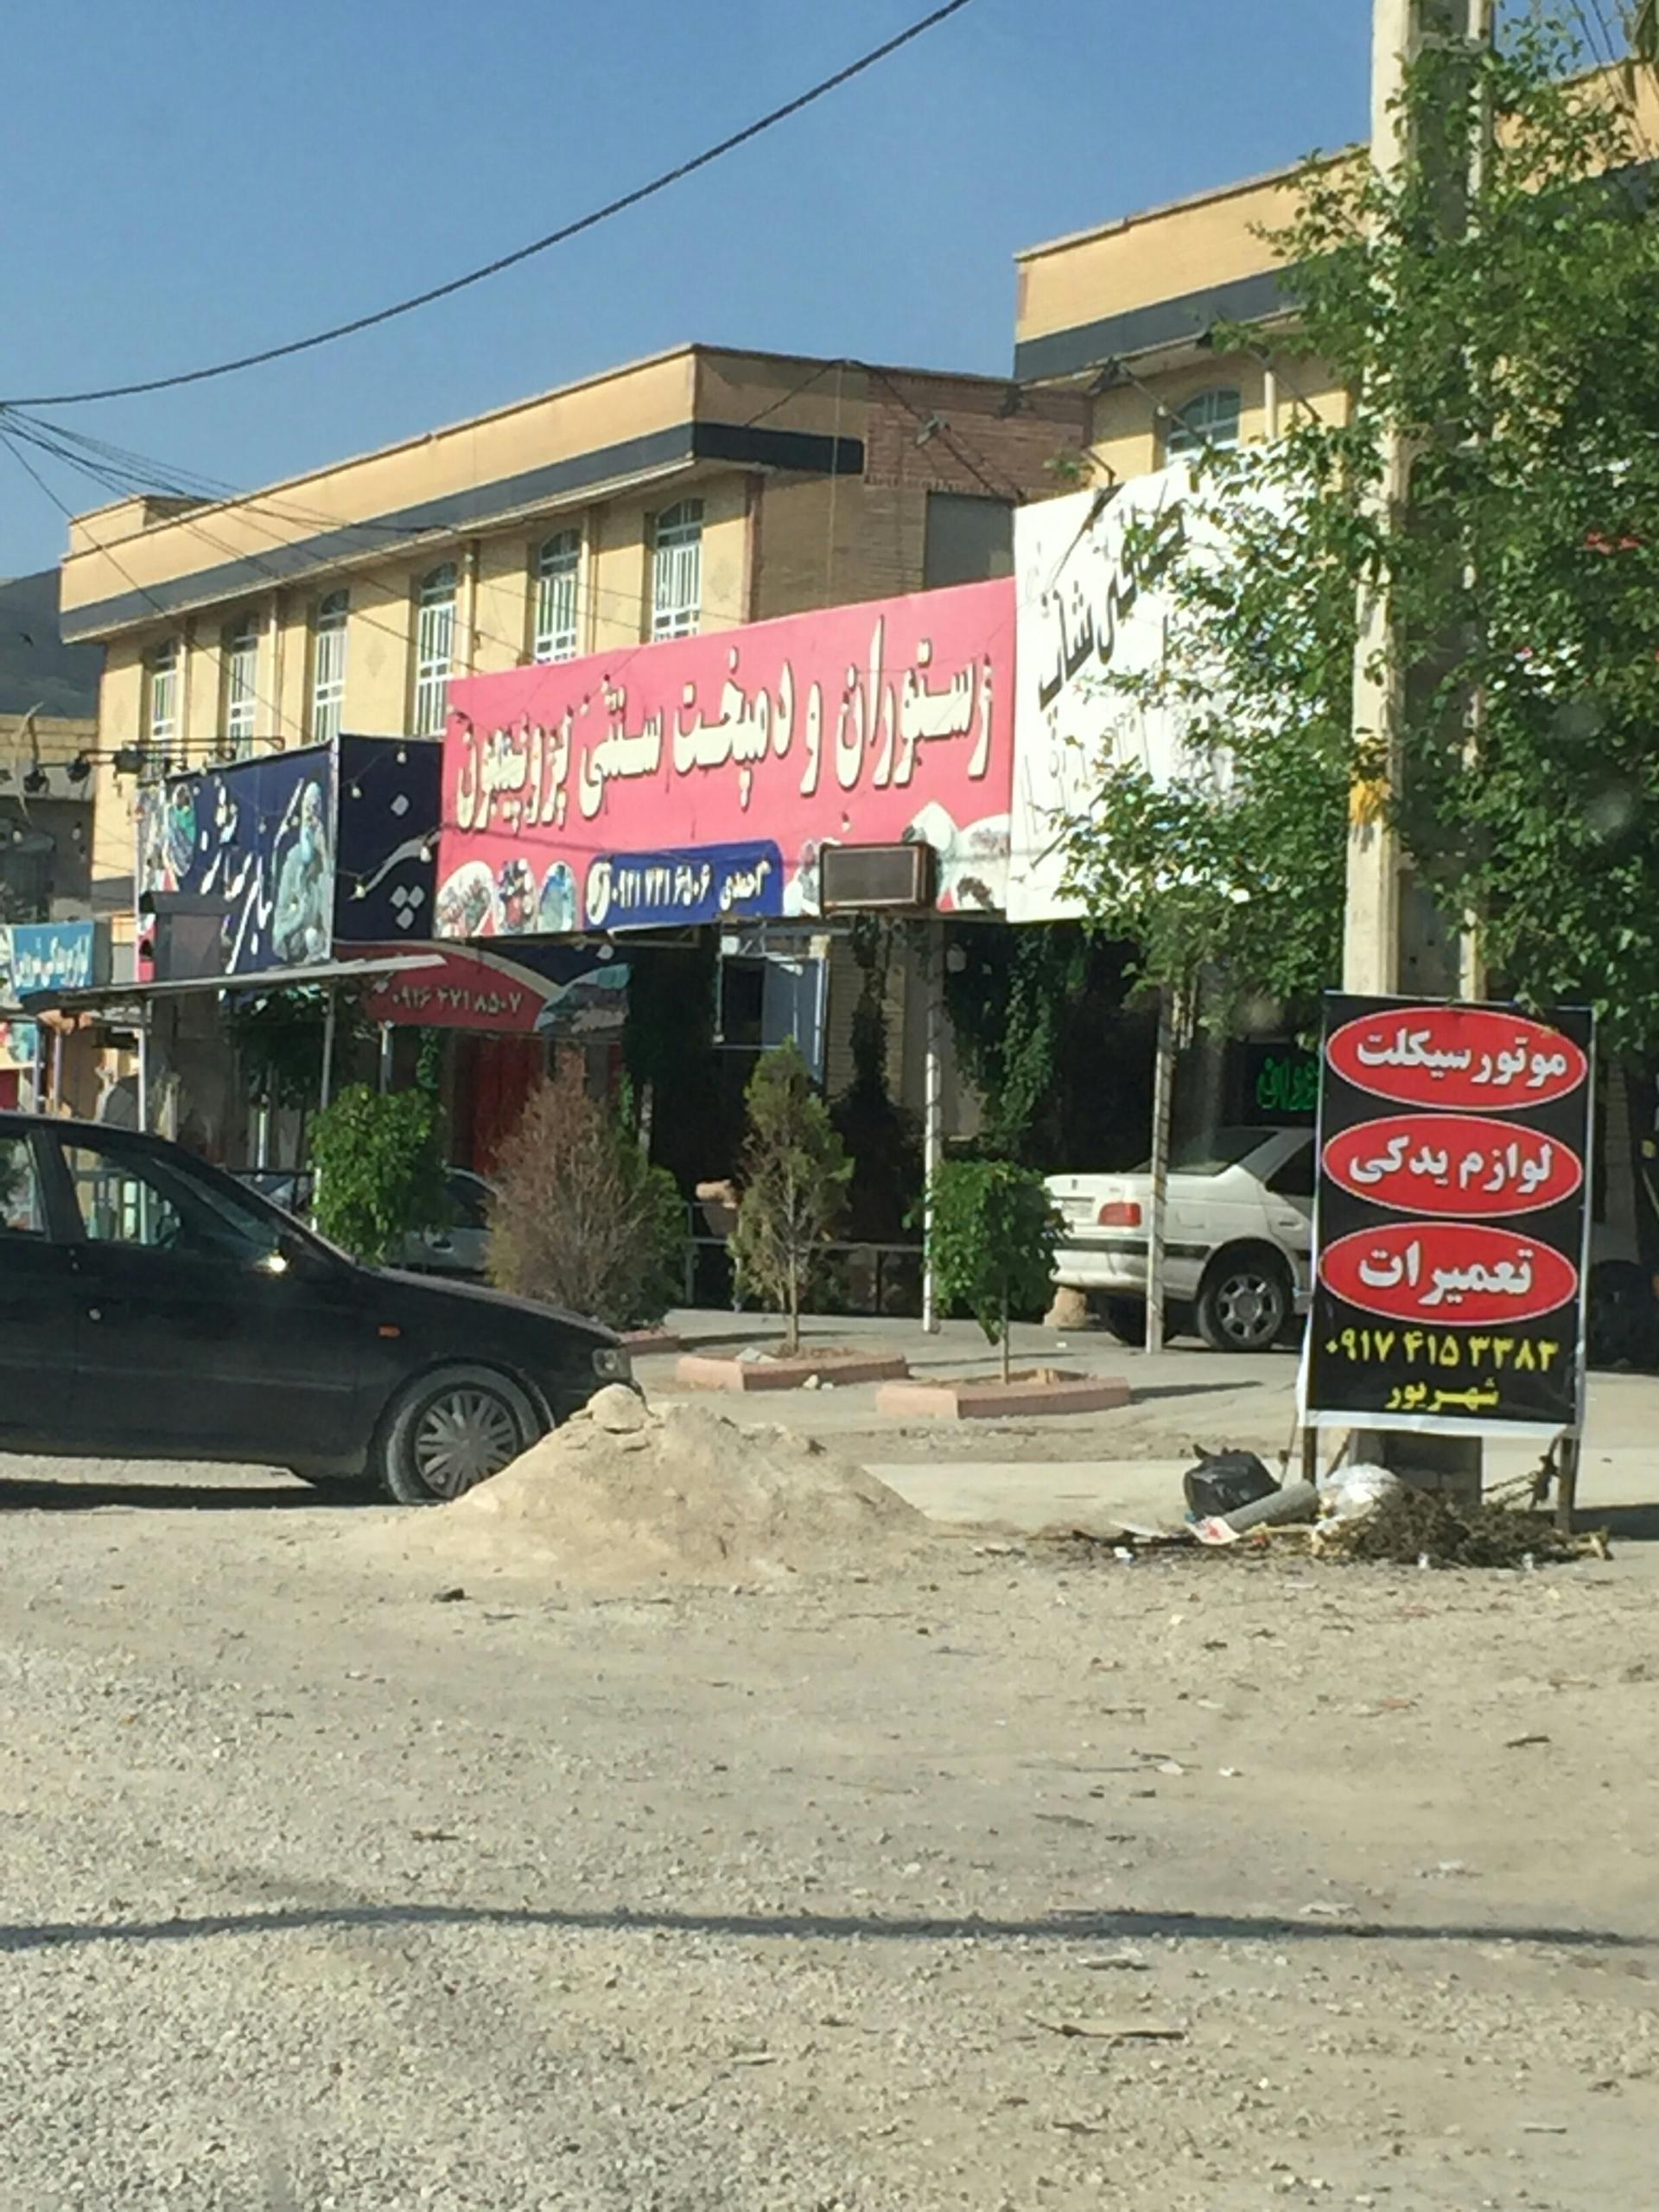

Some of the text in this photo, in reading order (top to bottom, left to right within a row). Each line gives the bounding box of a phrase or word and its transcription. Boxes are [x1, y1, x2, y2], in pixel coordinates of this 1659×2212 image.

[672, 645, 794, 812] دمپخت
[799, 680, 822, 796] و
[835, 614, 993, 788] رستوران
[579, 685, 664, 821] سنتی
[1356, 1027, 1567, 1089] موتور سیکلت
[1349, 1135, 1553, 1194] لوازم یدکی
[1357, 1240, 1534, 1306] تعمیرات
[1325, 1327, 1395, 1363] ۰۹۱۷
